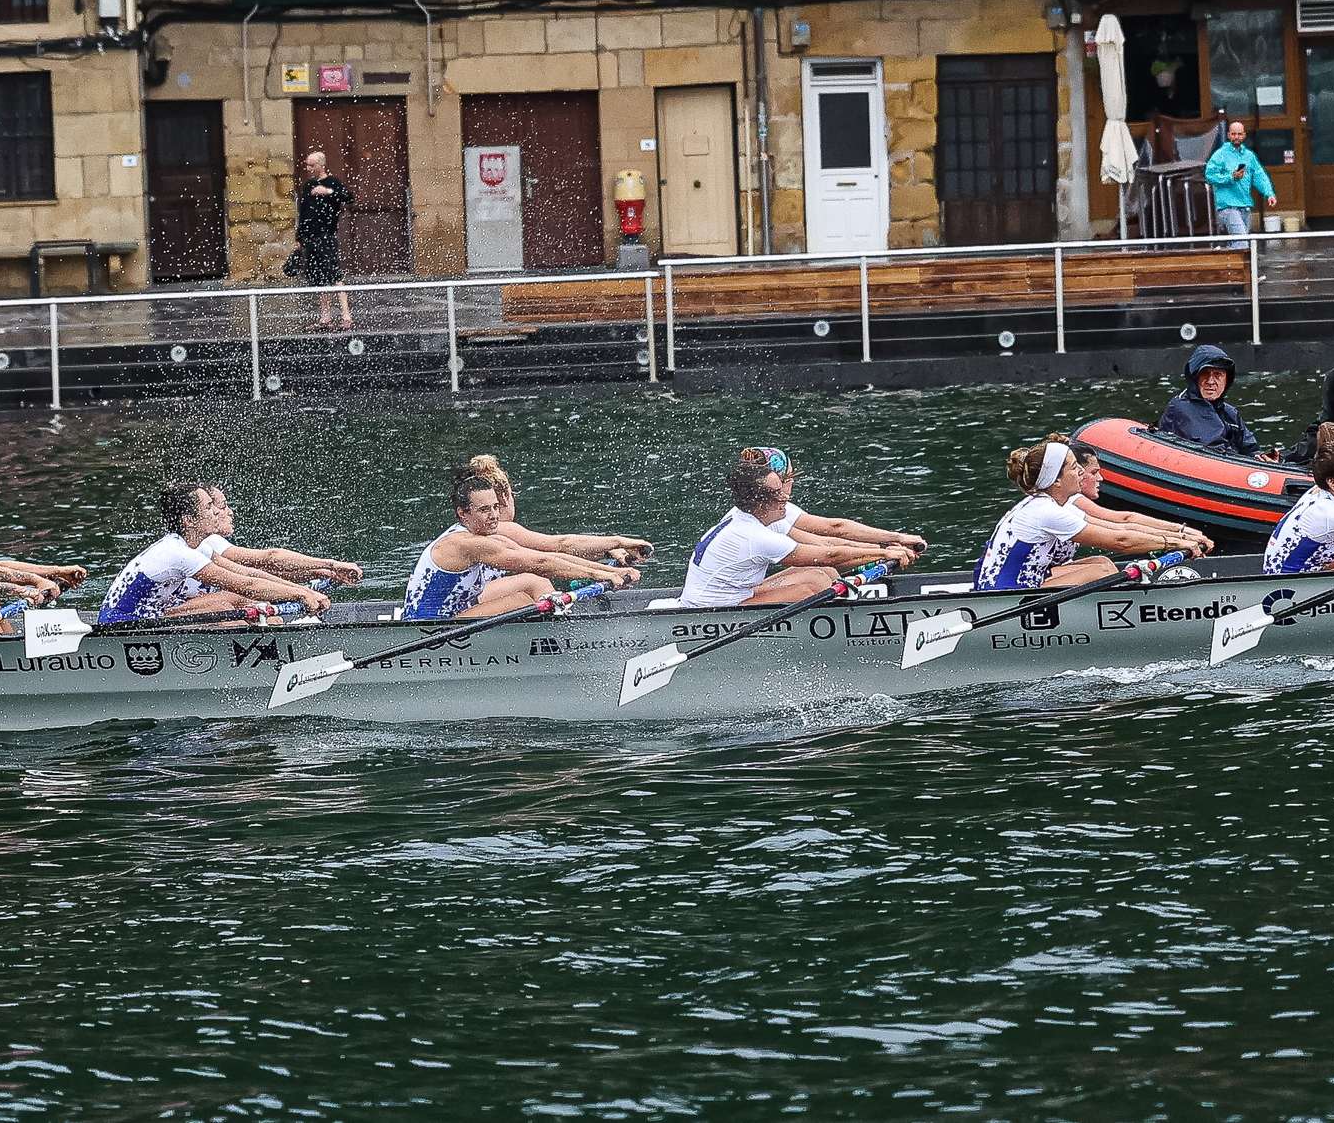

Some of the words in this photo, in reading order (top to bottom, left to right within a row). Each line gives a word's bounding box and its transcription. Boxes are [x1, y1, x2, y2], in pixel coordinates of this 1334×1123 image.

[1139, 600, 1239, 624] Etendo
[990, 632, 1091, 651] Edyma
[380, 655, 521, 669] BERRILAN
